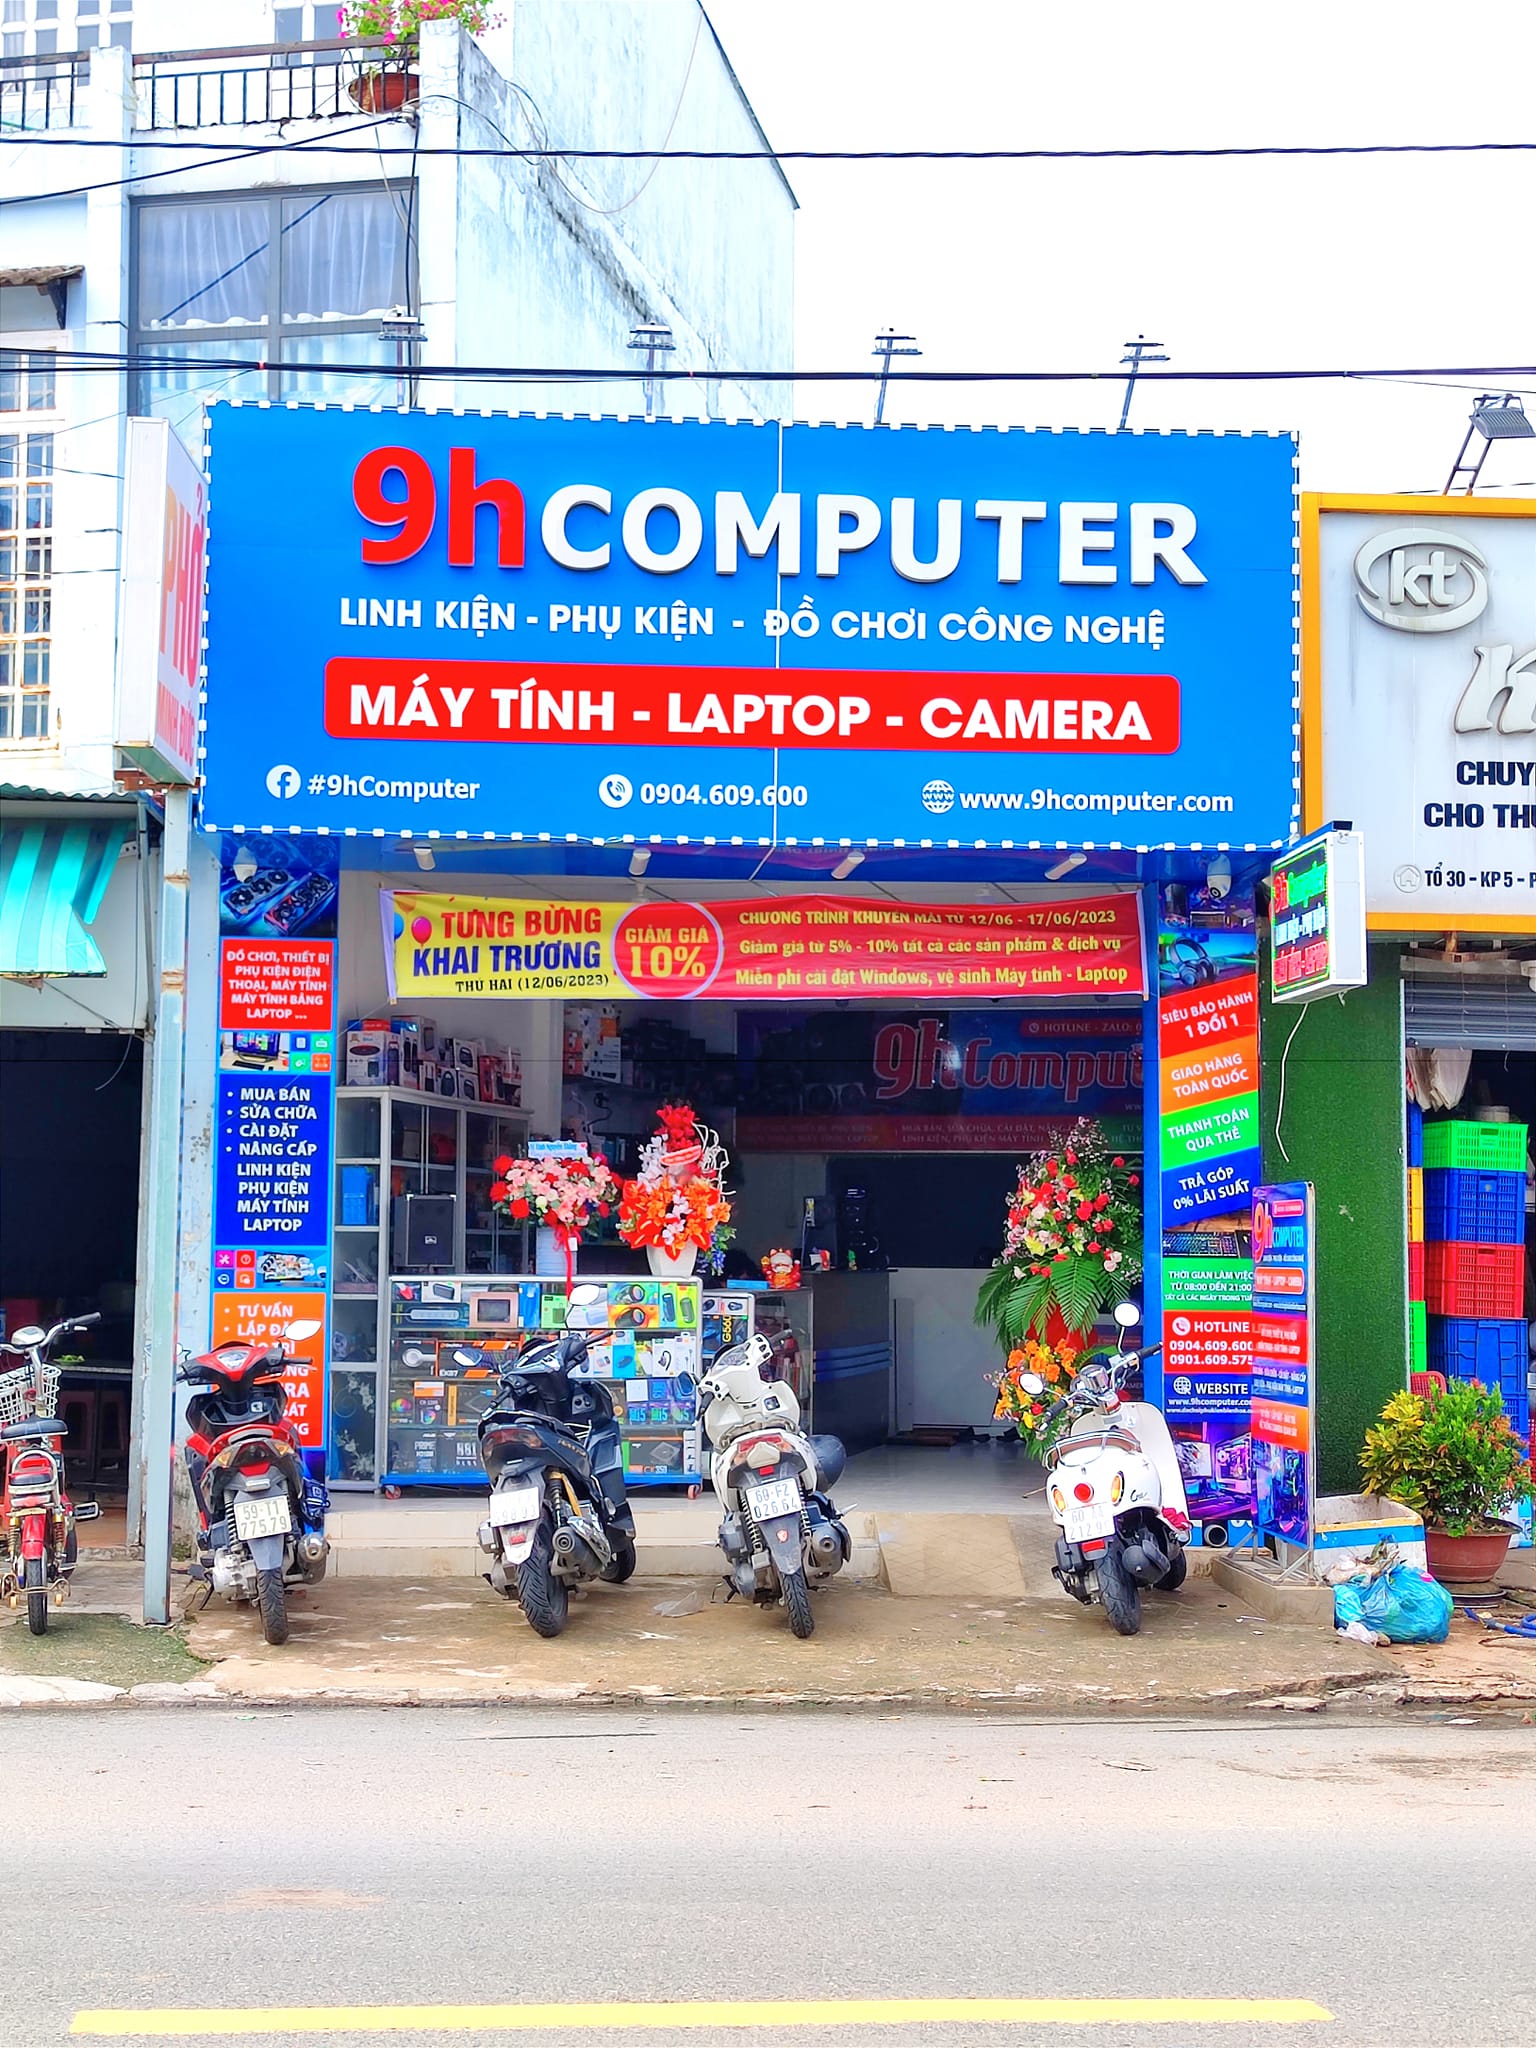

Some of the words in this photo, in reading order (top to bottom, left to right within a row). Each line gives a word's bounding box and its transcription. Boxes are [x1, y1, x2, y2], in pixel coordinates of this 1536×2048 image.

[341, 598, 422, 629] LINH
[435, 593, 515, 638] KIỆN
[550, 605, 621, 640] PHỤ
[635, 599, 714, 642] KIỆN
[764, 595, 820, 639] ĐỒ
[831, 608, 926, 640] CHƠI
[939, 606, 1054, 644] CÔNG
[1065, 609, 1165, 650] NGHỆ
[350, 673, 474, 727] MÁY
[491, 677, 615, 731] TÍNH
[667, 691, 870, 736] LAPTOP
[920, 696, 1152, 741] CAMERA
[1456, 761, 1536, 786] CHUY
[308, 774, 480, 802] #9hComputer
[641, 781, 808, 807] 0904.609.600
[960, 788, 1234, 815] www.9hcomputer.com
[1424, 803, 1484, 828] CHO
[1493, 804, 1536, 828] TH
[1424, 861, 1443, 887] TỔ
[1446, 870, 1465, 887] 30
[1480, 871, 1501, 888] KP
[1503, 871, 1513, 888] 5
[441, 908, 515, 939] TƯNG
[525, 904, 601, 937] BỪNG
[739, 910, 801, 925] CHƯƠNG
[969, 912, 1014, 927] 12/06
[1027, 910, 1116, 927] 17/06/2023
[739, 939, 777, 954] Giảm
[829, 939, 852, 953] 5%
[866, 940, 899, 953] 10%
[948, 939, 971, 953] các
[975, 937, 1001, 953] sản
[1051, 937, 1064, 951] &
[1068, 935, 1098, 954] dịch
[1103, 938, 1121, 953] vụ
[247, 951, 280, 963] CHƠI,
[282, 950, 316, 963] THIẾT
[318, 952, 330, 966] BỊ
[413, 945, 479, 977] KHAI
[489, 940, 601, 972] TRƯƠNG
[631, 945, 706, 978] 10%
[235, 965, 260, 977] PHỤ
[262, 965, 290, 979] KIỆN
[859, 967, 932, 987] Windows,
[959, 967, 991, 984] sinh
[995, 967, 1027, 988] Máy
[1031, 966, 1062, 982] tính
[1076, 966, 1127, 985] Laptop
[228, 979, 269, 992] THOẠI,
[271, 979, 297, 991] MÁY
[299, 978, 327, 992] TÍNH
[489, 978, 512, 990] HAI
[518, 974, 609, 991] (12/06/2023)
[231, 993, 257, 1005] MÁY
[259, 993, 289, 1005] TÍNH
[1162, 1007, 1189, 1025] SIÊU
[1191, 1001, 1216, 1018] BẢO
[1218, 992, 1253, 1012] HÀNH
[246, 1008, 293, 1019] LAPTOP
[1044, 1023, 1091, 1032] HOTLINE
[1185, 1025, 1194, 1038] 1
[1230, 1013, 1240, 1027] 1
[1171, 1063, 1203, 1082] GIAO
[1205, 1053, 1242, 1074] HÀNG
[240, 1087, 275, 1101] MUA
[278, 1086, 310, 1101] BÁN
[1173, 1079, 1210, 1099] TOÀN
[1211, 1069, 1249, 1090] QUỐC
[239, 1103, 271, 1120] SỬA
[274, 1105, 318, 1120] CHỮA
[239, 1122, 265, 1138] CÀI
[268, 1122, 299, 1141] ĐẶT
[1167, 1119, 1212, 1140] THANH
[1213, 1108, 1250, 1128] TOÁN
[239, 1141, 283, 1156] NÂNG
[286, 1140, 318, 1156] CẤP
[1186, 1136, 1213, 1152] QUA
[1214, 1126, 1241, 1146] THẺ
[237, 1163, 272, 1177] LINH
[276, 1162, 311, 1180] KIỆN
[1179, 1171, 1204, 1192] TRẢ
[1206, 1166, 1234, 1184] GÓP
[238, 1182, 271, 1197] PHỤ
[273, 1180, 309, 1198] KIỆN
[1172, 1196, 1194, 1211] 0%
[1219, 1180, 1250, 1198] SUẤT
[237, 1199, 270, 1213] MÁY
[272, 1198, 309, 1213] TÍNH
[243, 1218, 302, 1232] LAPTOP
[1191, 1271, 1213, 1279] GIAN
[1228, 1283, 1252, 1291] 21:00
[237, 1302, 261, 1317] TƯ
[261, 1301, 293, 1317] VẤN
[1194, 1321, 1250, 1333] HOTLINE
[1195, 1383, 1249, 1395] WEBSITE
[1168, 1397, 1252, 1408] www.9hcomputer.co
[243, 1501, 281, 1521] 59-T1
[241, 1516, 287, 1537] 775.79
